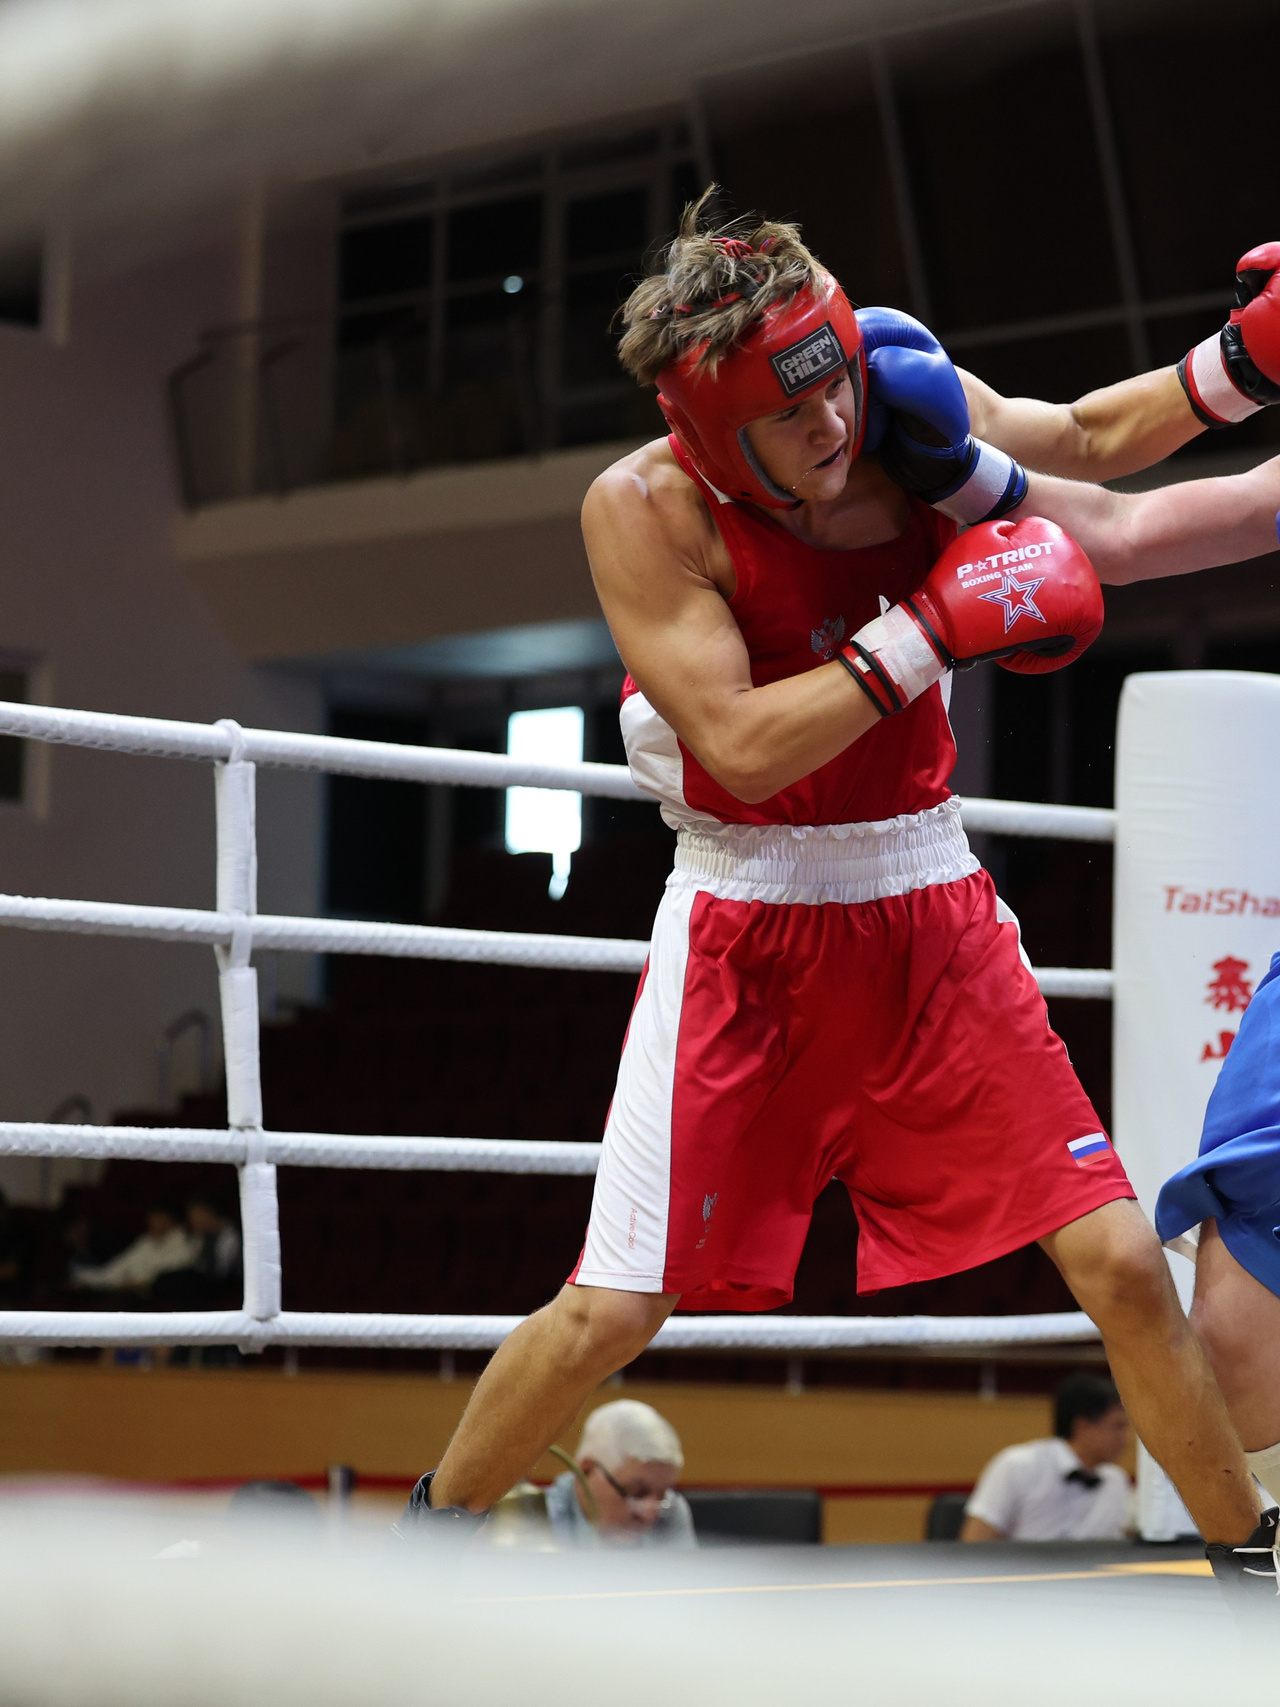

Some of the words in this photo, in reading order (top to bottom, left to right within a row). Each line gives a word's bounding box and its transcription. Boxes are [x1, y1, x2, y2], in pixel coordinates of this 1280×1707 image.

[781, 335, 831, 371] GREEN
[785, 352, 832, 385] HILL
[960, 571, 1002, 589] BOXING
[1003, 562, 1034, 576] TEAM
